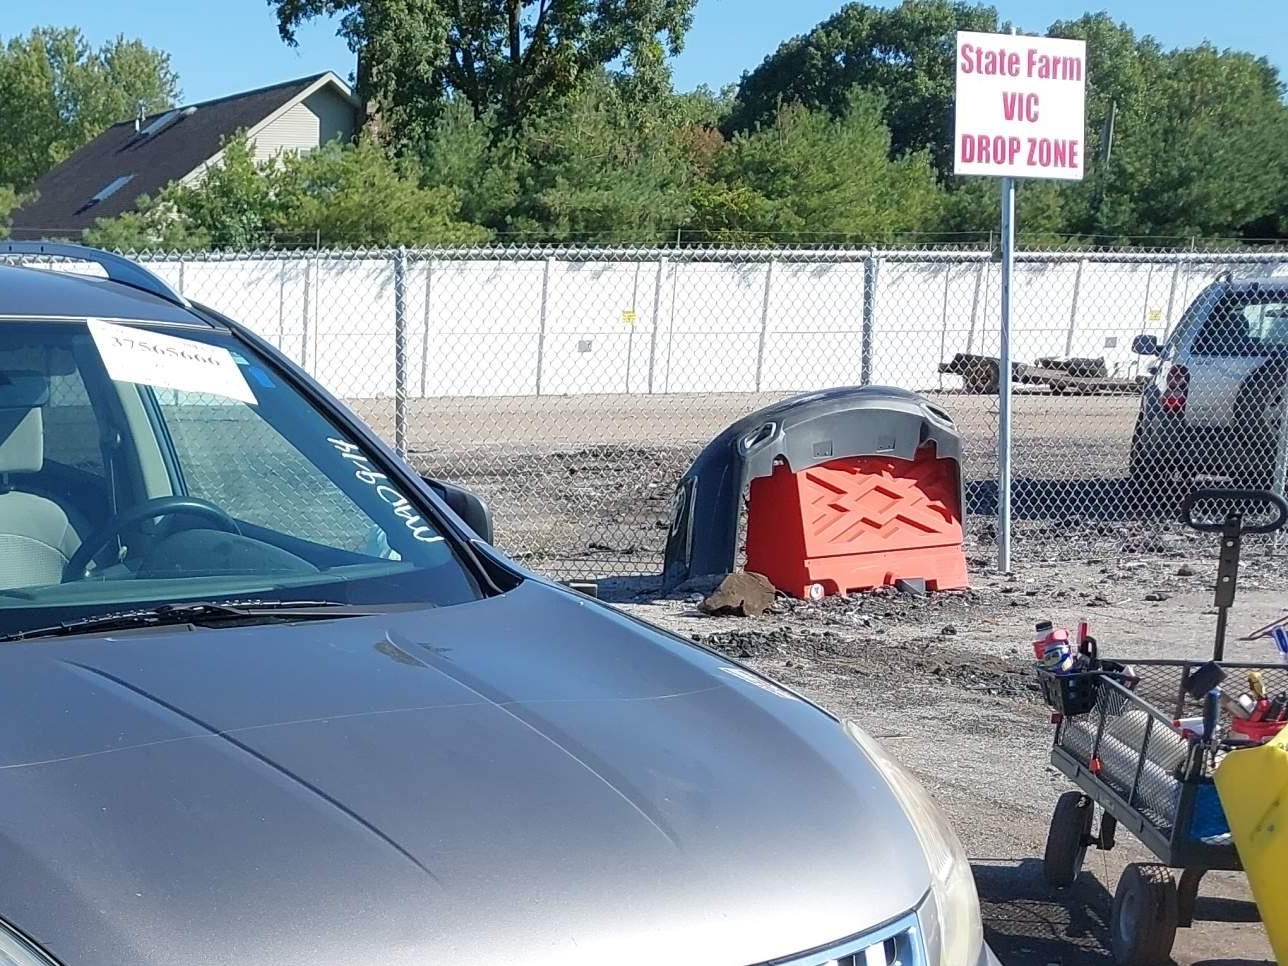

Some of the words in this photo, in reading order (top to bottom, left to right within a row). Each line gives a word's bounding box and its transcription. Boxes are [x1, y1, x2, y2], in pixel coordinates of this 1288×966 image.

[960, 43, 1021, 77] State
[1027, 48, 1082, 82] Farm
[1002, 91, 1040, 123] VIC
[960, 133, 1021, 166] DROP
[1026, 137, 1079, 169] ZONE
[111, 336, 222, 367] 37565666
